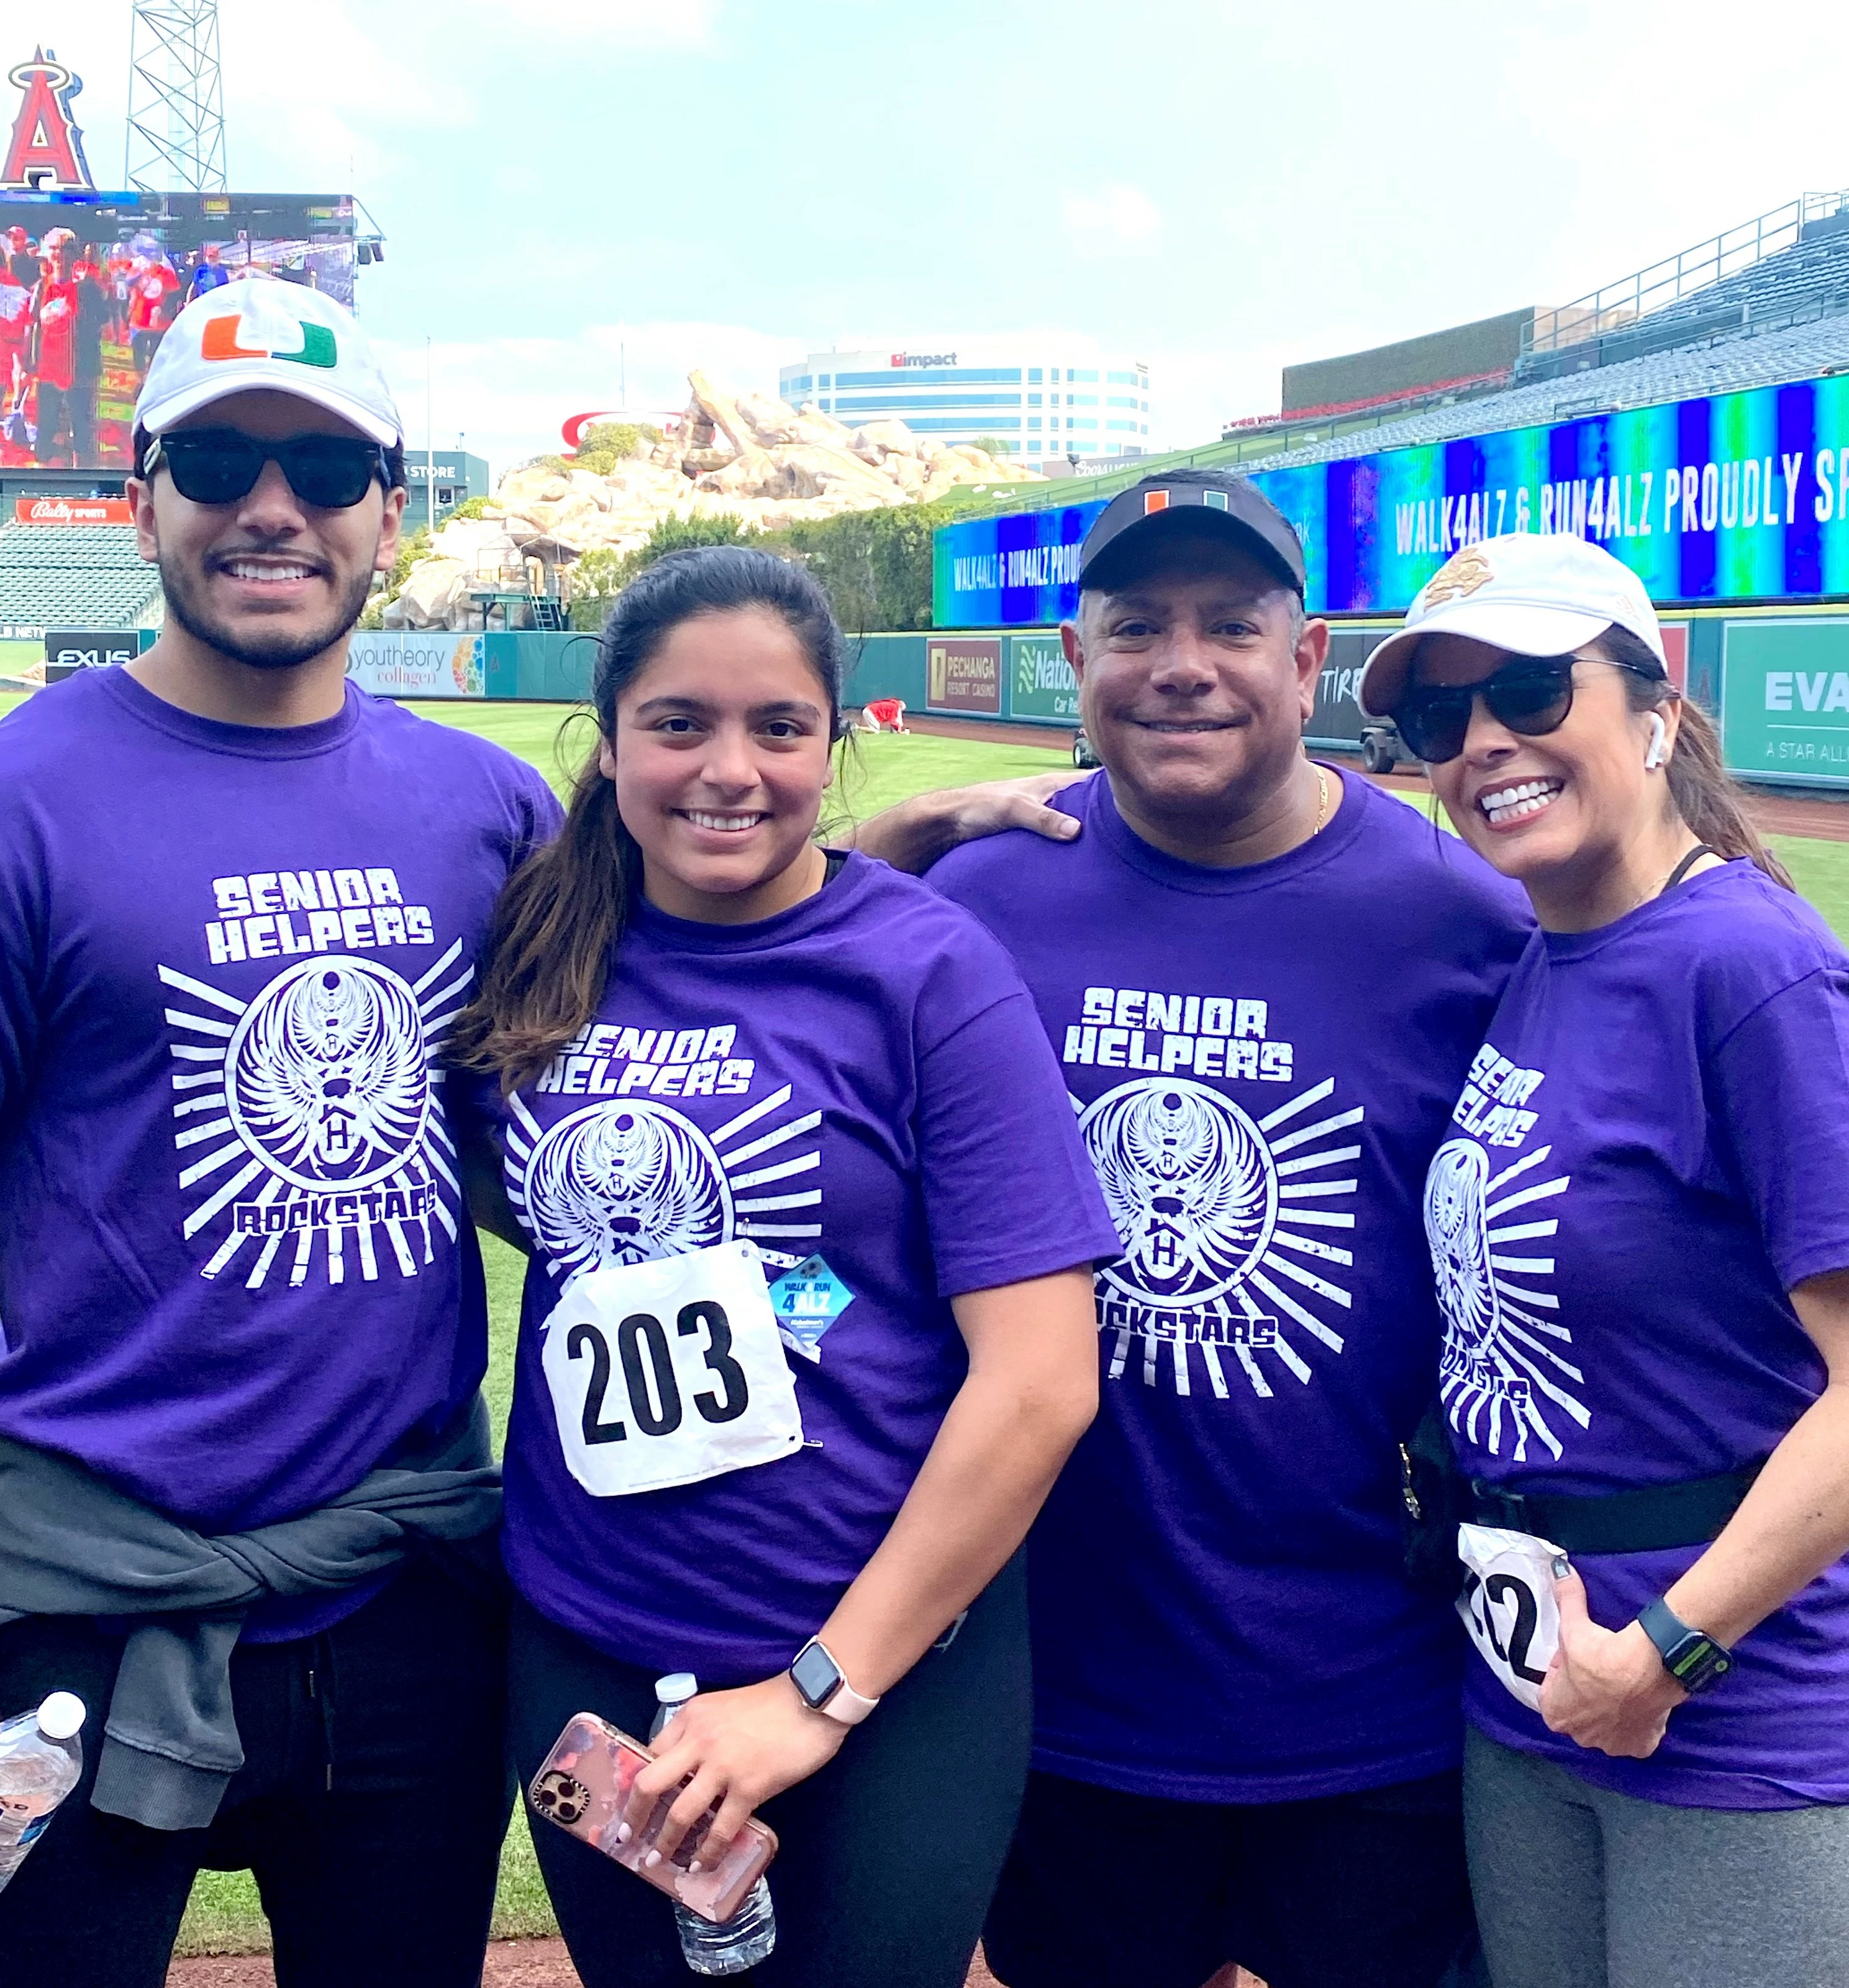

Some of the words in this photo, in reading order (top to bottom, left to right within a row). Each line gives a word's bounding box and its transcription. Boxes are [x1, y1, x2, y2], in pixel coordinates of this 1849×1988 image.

[903, 352, 957, 368] impact
[410, 465, 456, 478] STORE
[1664, 452, 1804, 533] PROUDLY
[30, 502, 74, 522] Bally
[74, 508, 107, 518] SPORTS
[953, 554, 996, 591] WALK4ALZ
[1008, 546, 1048, 588] RUN4ALZ
[46, 650, 131, 667] LEXUS
[353, 644, 445, 672] youtheory
[947, 656, 995, 679] PECHANGA
[377, 666, 436, 690] collagen
[947, 681, 970, 696] RESORT
[972, 683, 995, 697] CASINO
[1054, 696, 1067, 713] Car
[1766, 742, 1775, 758] A
[1779, 742, 1815, 760] STAR
[212, 867, 404, 919] SENIOR
[205, 905, 435, 965] HELPERS
[1081, 987, 1268, 1039] SENIOR
[1063, 1025, 1294, 1082] HELPERS
[535, 1055, 756, 1097] HELPERS
[784, 1282, 806, 1292] WALK
[814, 1282, 831, 1292] RUN
[782, 1292, 831, 1314] 4ALZ
[566, 1300, 749, 1446] 203
